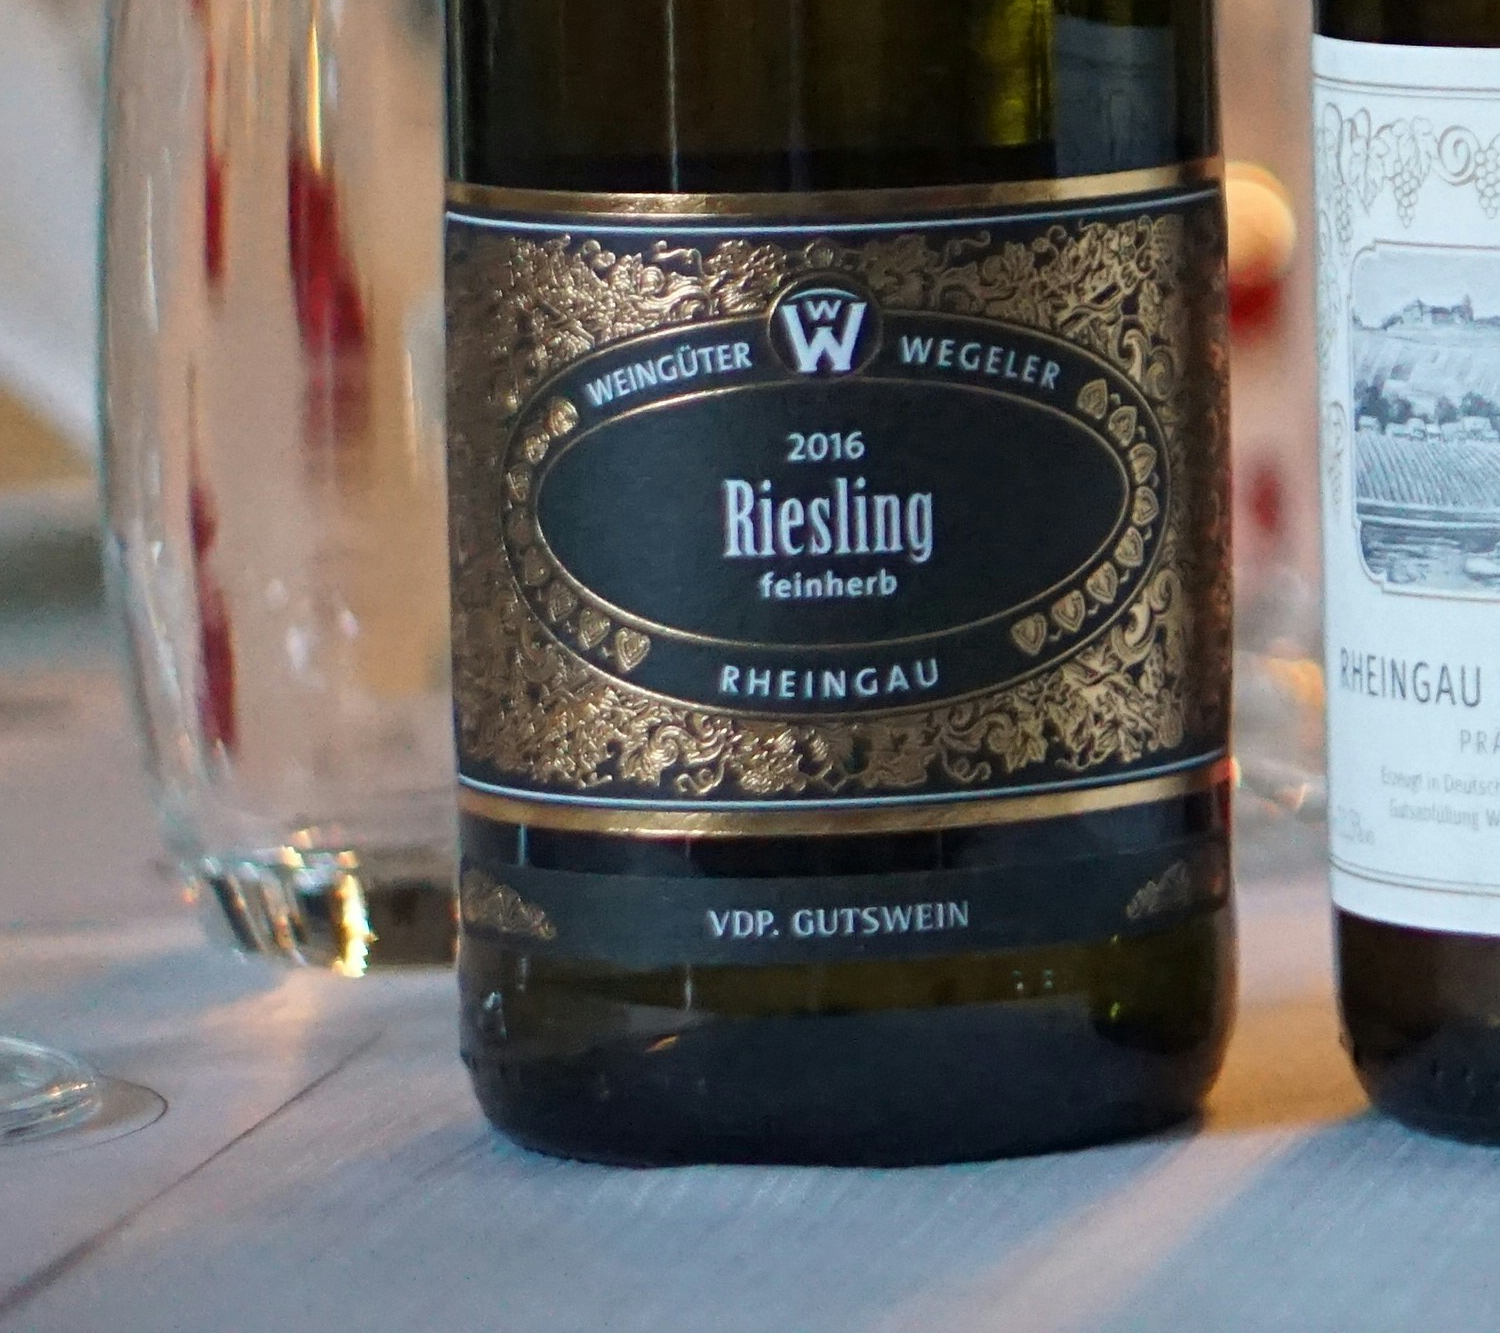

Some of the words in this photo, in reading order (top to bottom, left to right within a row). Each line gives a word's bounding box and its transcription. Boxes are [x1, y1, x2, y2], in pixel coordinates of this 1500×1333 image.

[585, 340, 754, 408] WEINGÜTER
[898, 334, 1065, 391] WEGELER
[786, 431, 867, 463] 2016
[723, 476, 936, 565] Riesling
[759, 569, 899, 600] feinherb
[717, 658, 942, 700] RHEINGAU
[1338, 647, 1484, 708] RHEINGAU
[707, 907, 782, 941] VDP.
[791, 899, 971, 938] GUTSWEIN
